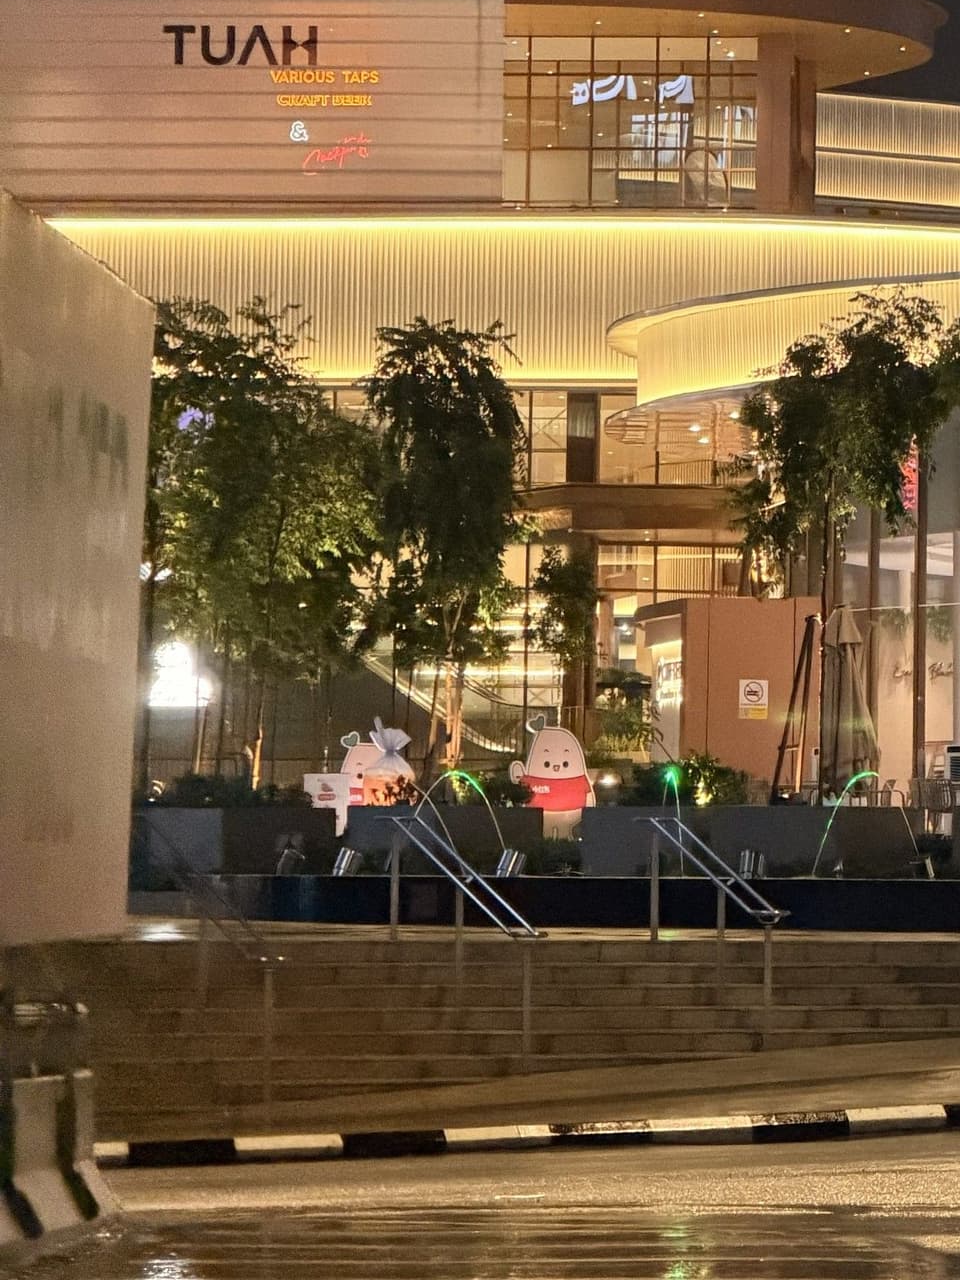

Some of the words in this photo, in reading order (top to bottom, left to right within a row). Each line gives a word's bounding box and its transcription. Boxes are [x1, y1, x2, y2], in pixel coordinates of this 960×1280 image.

[163, 24, 318, 66] TUAH
[270, 70, 336, 84] VARIOUS
[341, 70, 380, 84] TAPS
[276, 94, 330, 107] CRAFT
[289, 120, 309, 142] &
